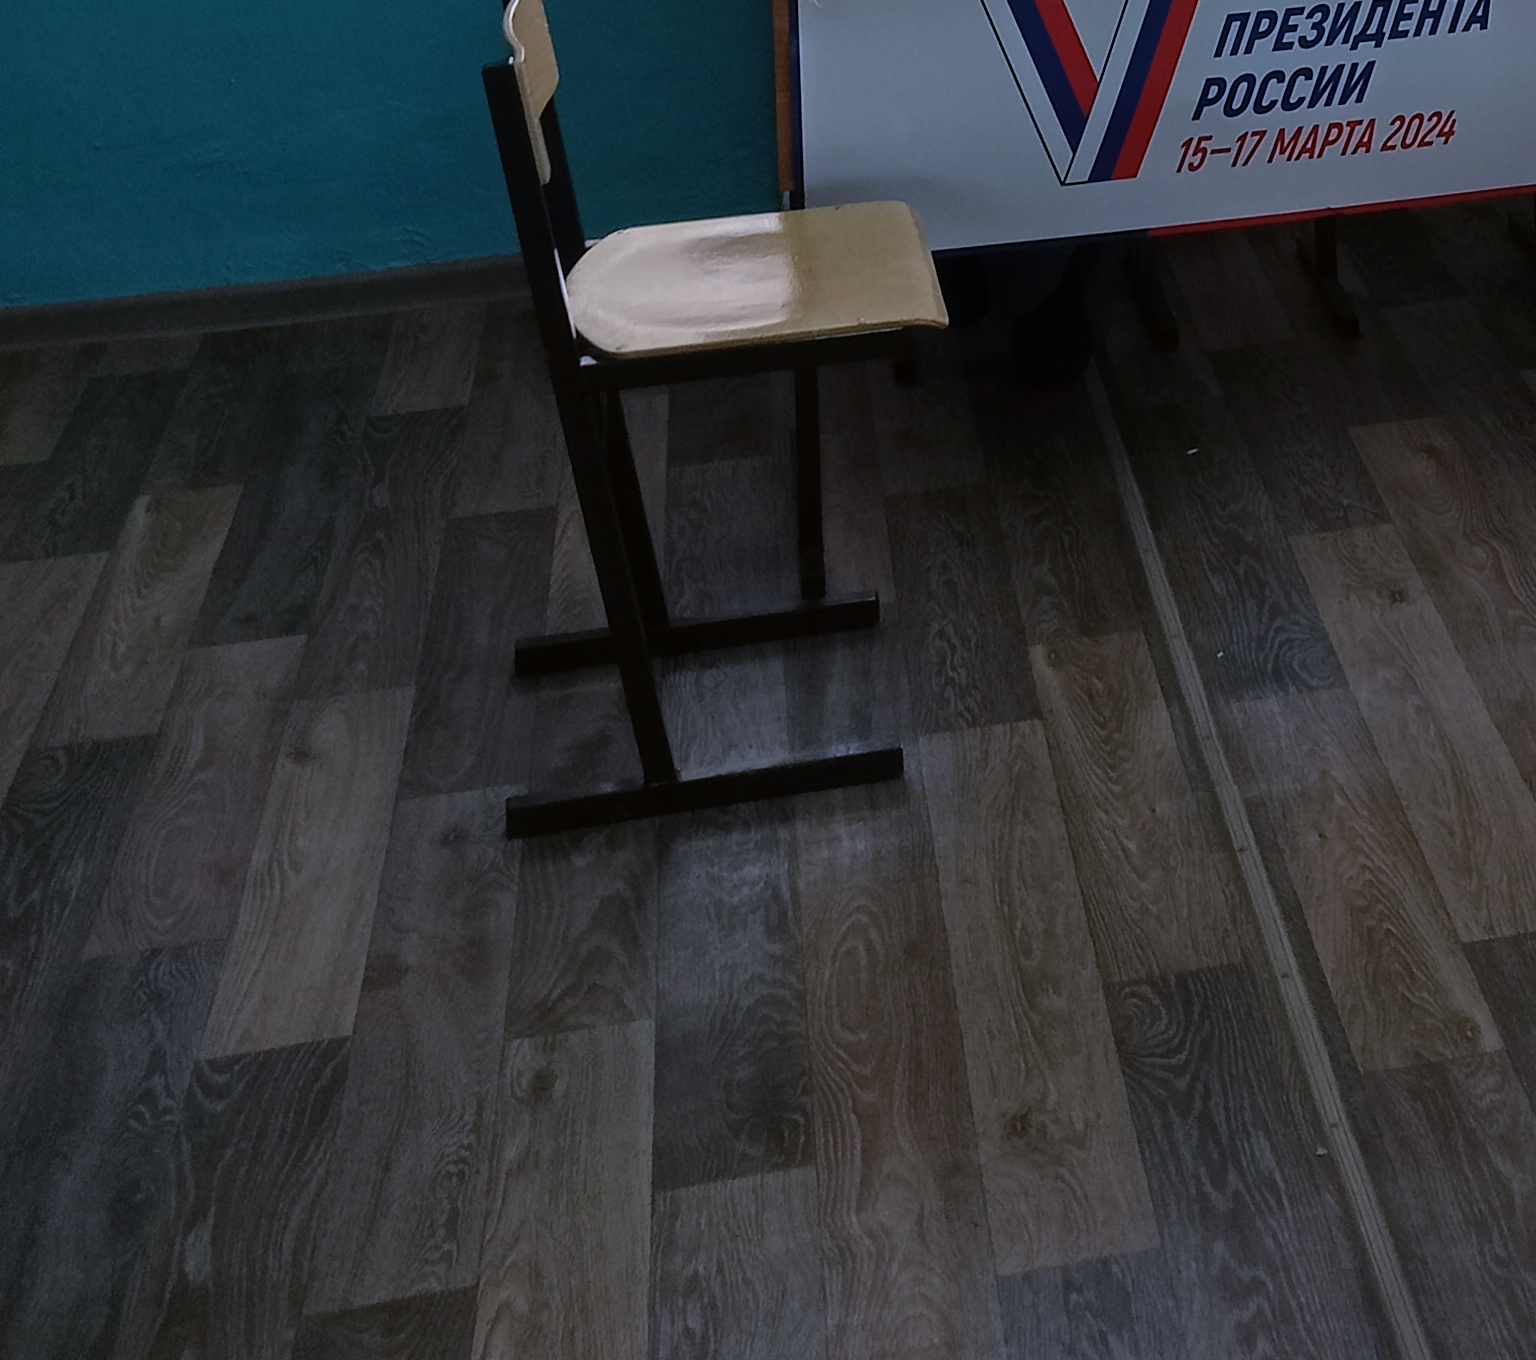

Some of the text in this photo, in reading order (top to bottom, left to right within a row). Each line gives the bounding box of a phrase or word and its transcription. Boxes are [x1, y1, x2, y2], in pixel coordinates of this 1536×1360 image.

[1191, 60, 1376, 121] РОССИИ
[1268, 117, 1375, 165] МАРТА
[1380, 110, 1457, 152] 2024
